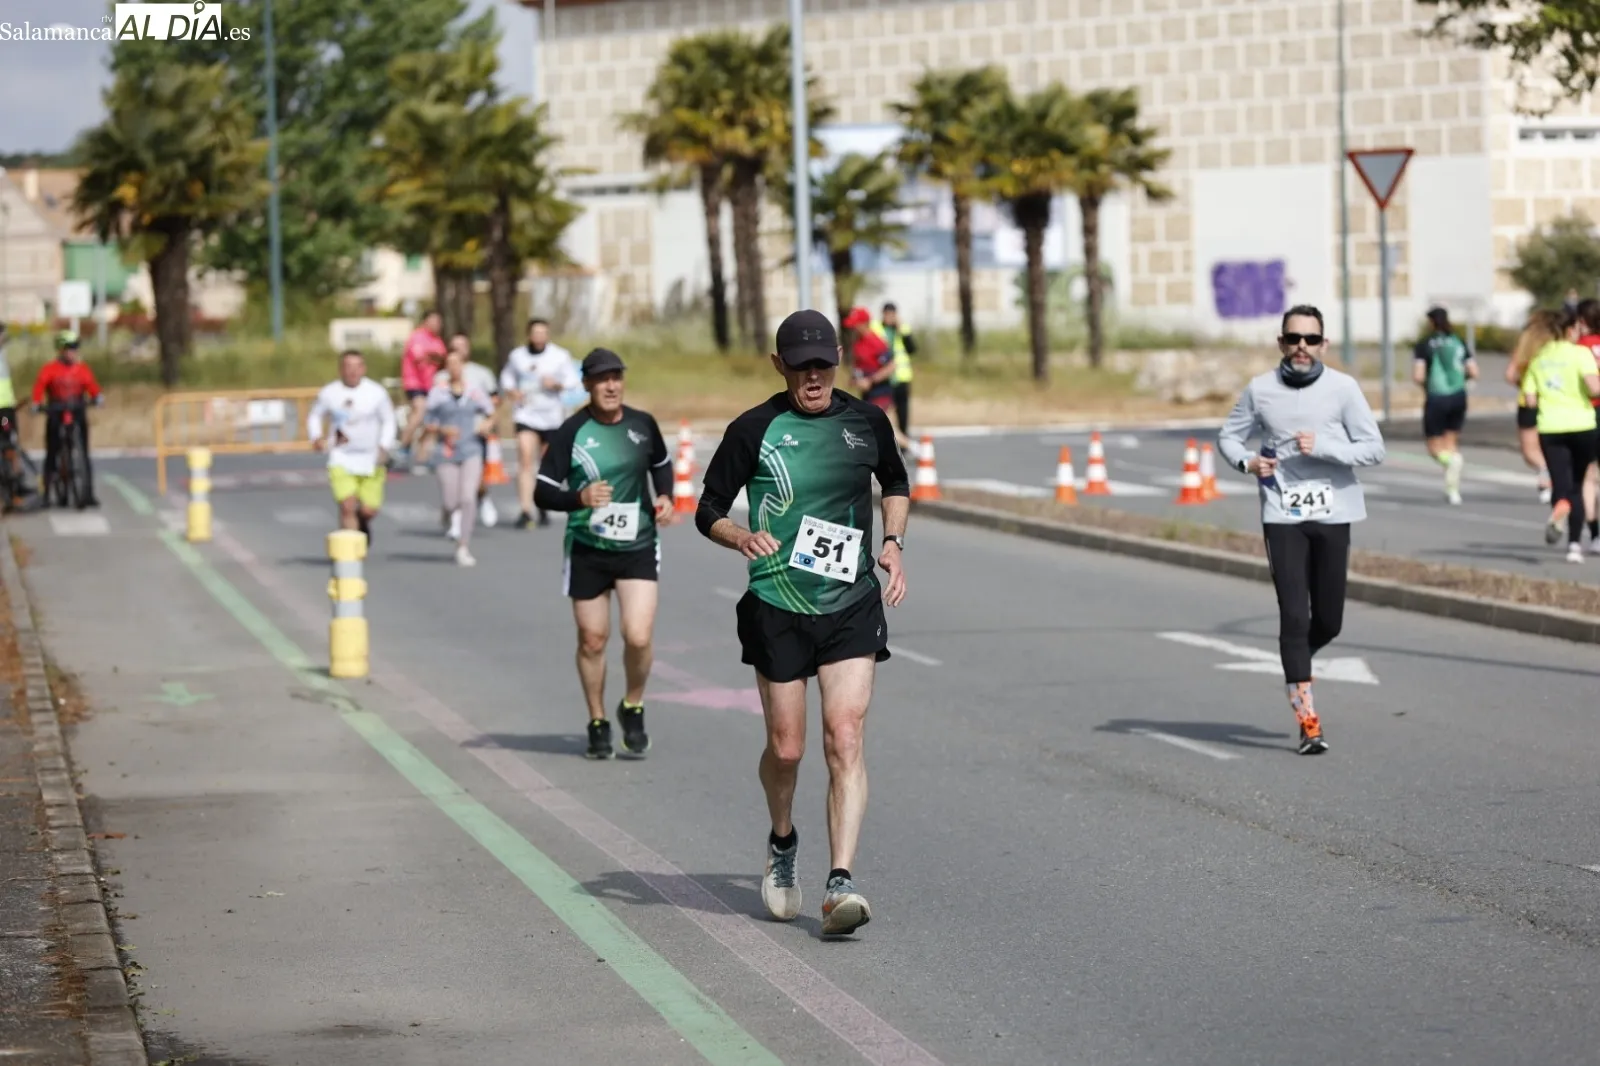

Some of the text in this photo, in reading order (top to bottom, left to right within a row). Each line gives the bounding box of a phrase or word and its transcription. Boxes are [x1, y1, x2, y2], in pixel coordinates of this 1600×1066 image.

[1290, 491, 1326, 508] 241
[603, 513, 628, 529] 45
[812, 535, 845, 563] 51
